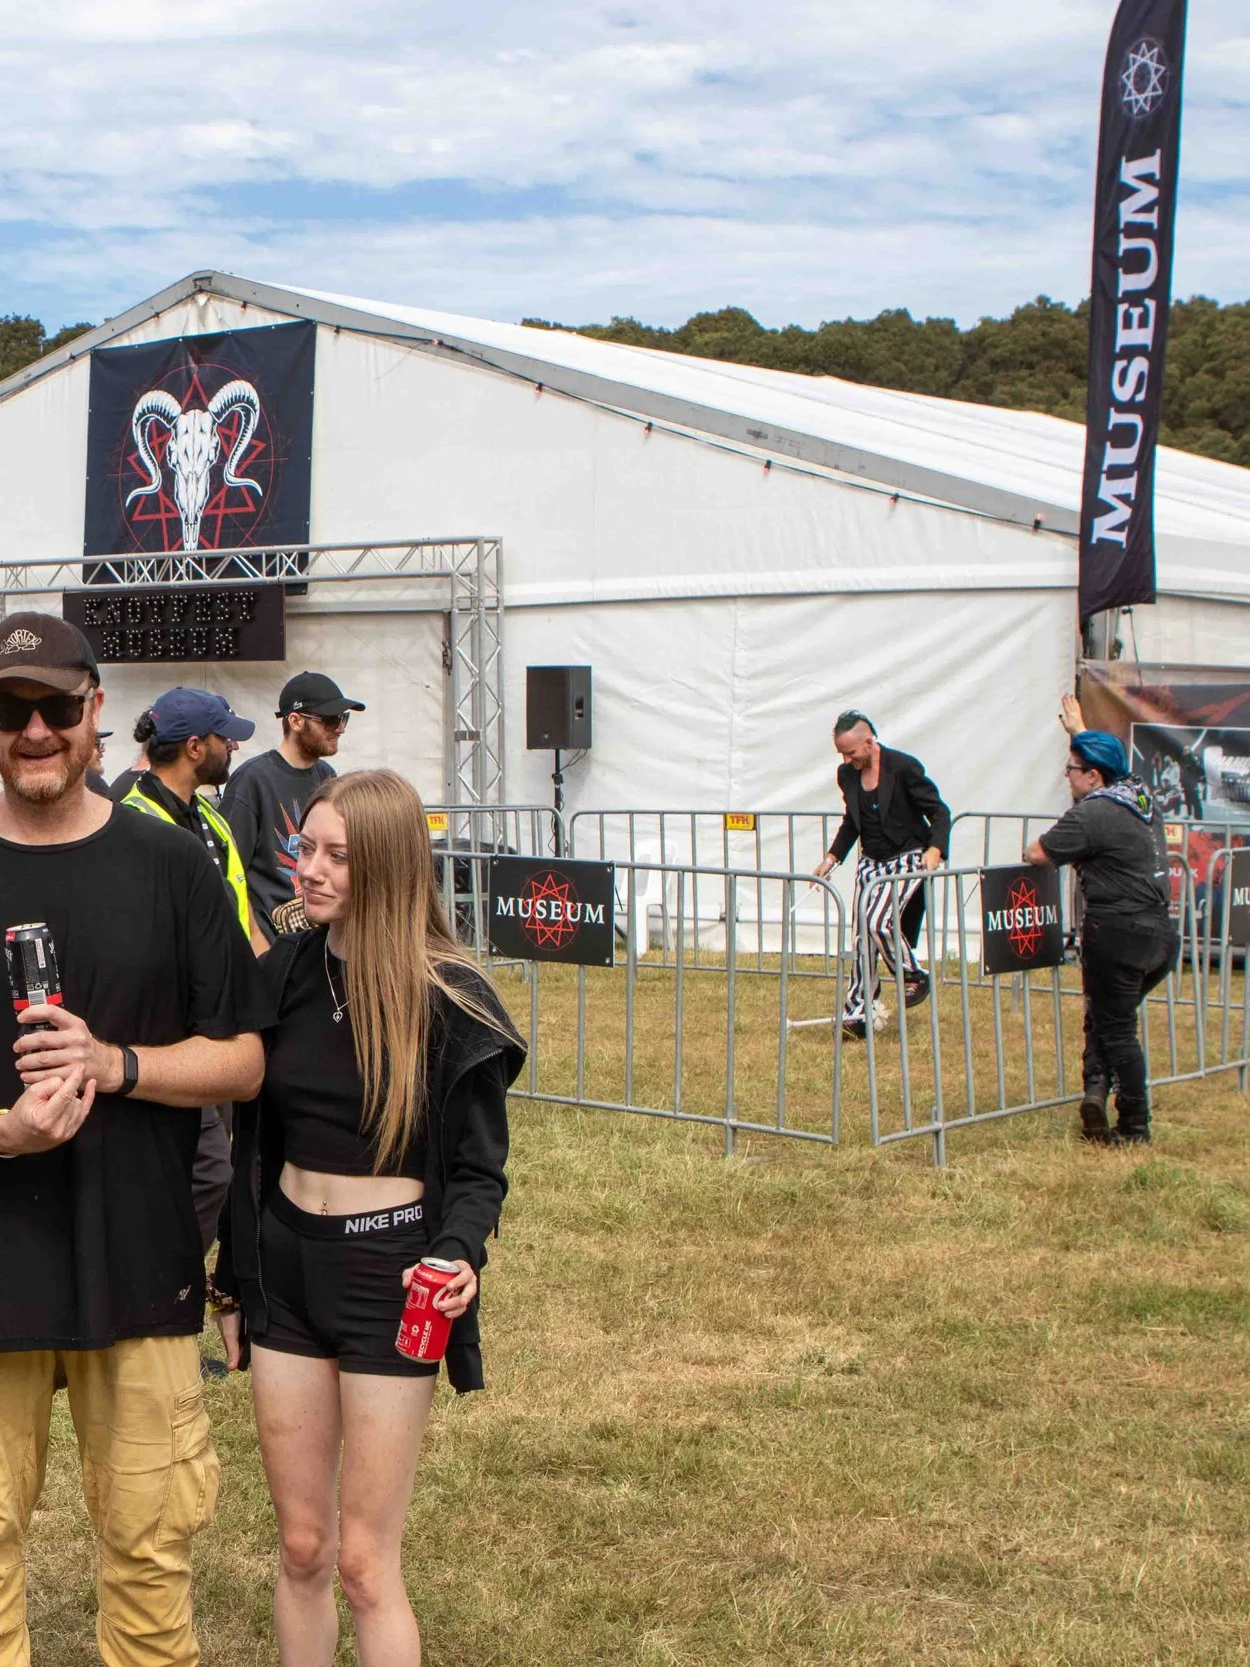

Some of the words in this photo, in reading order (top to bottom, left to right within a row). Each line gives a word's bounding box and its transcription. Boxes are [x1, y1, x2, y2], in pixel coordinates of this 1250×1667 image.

[1091, 149, 1161, 549] MUSEUM
[496, 896, 605, 924] MUSEUM
[987, 905, 1058, 931] MUSEUM
[344, 1214, 389, 1234] NIKE
[393, 1205, 423, 1226] PRO
